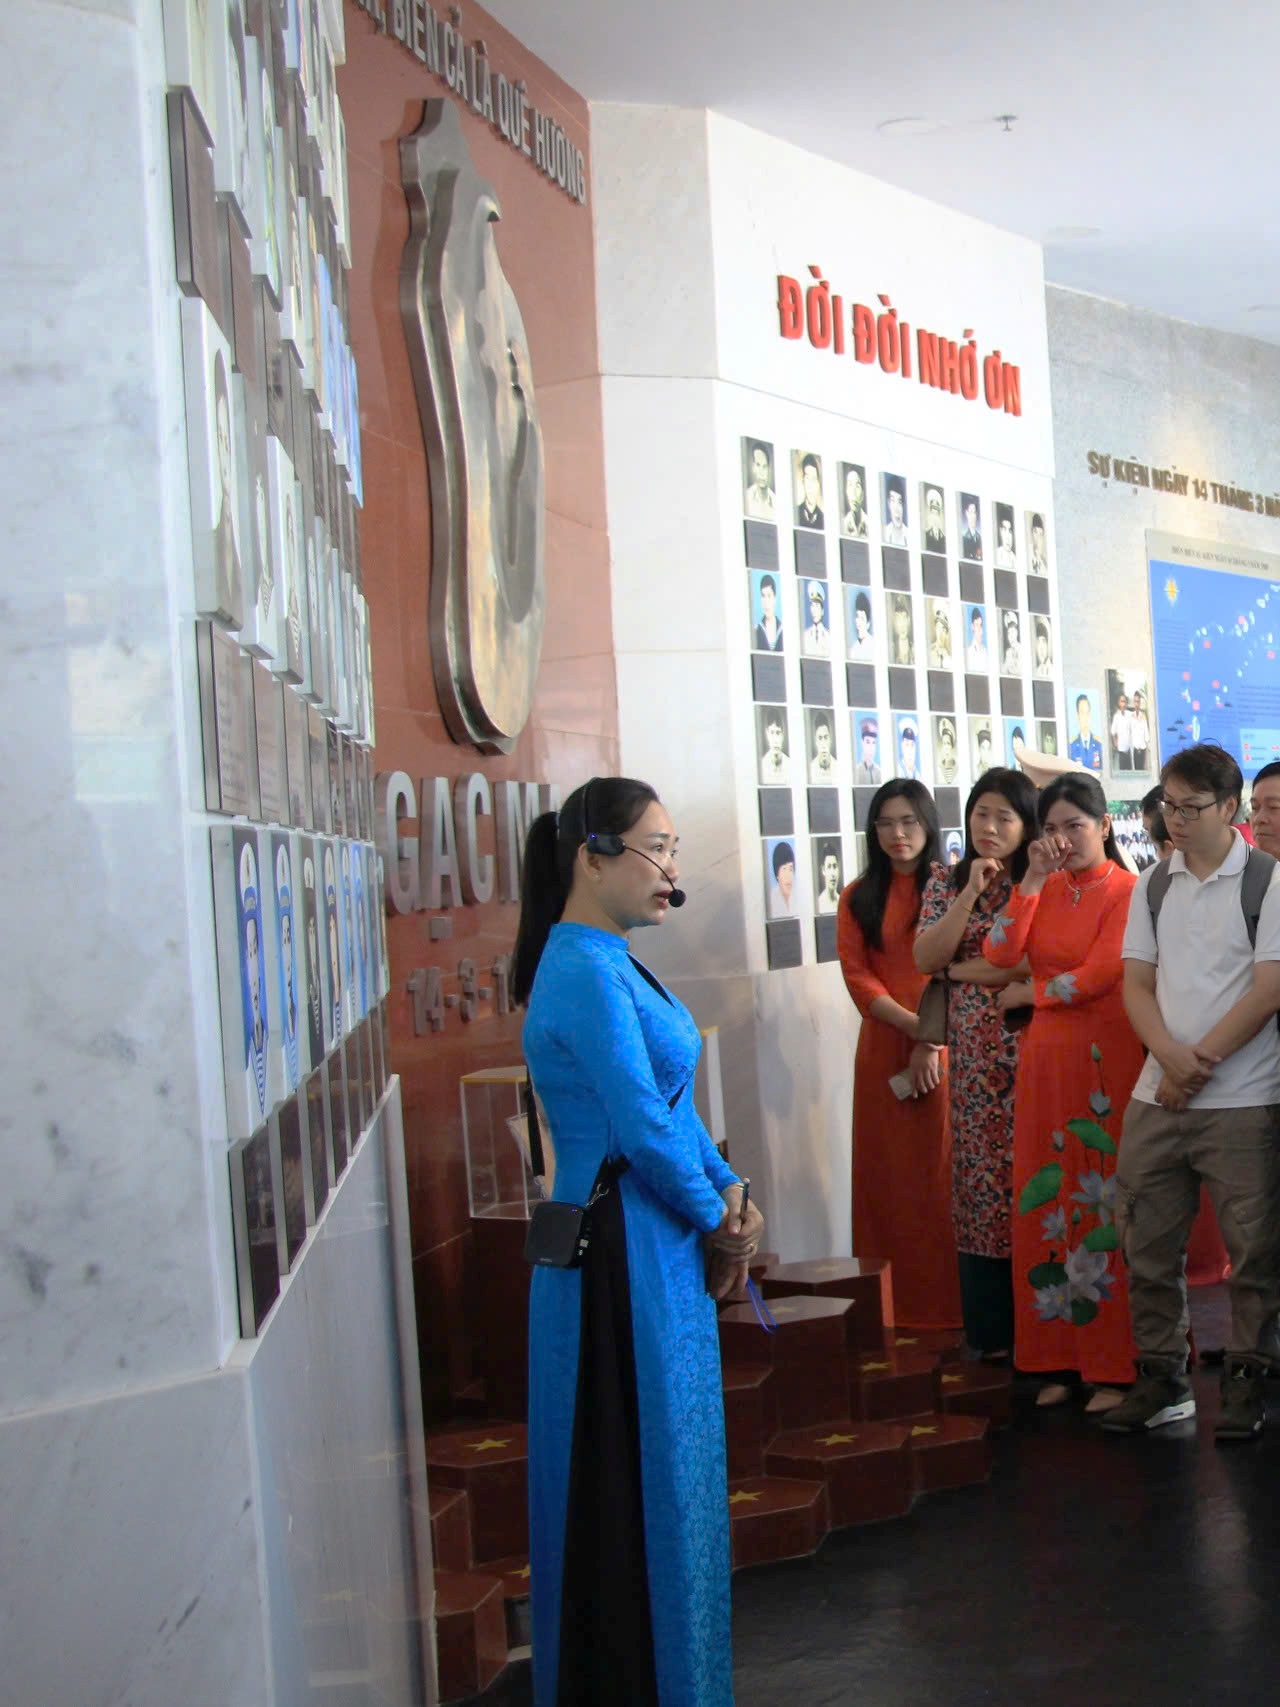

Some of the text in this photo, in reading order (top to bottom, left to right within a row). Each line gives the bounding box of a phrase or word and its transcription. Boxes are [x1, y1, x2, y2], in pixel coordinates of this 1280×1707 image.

[468, 40, 495, 123] LÀ
[494, 72, 531, 157] QUÊ
[532, 108, 586, 206] HƯƠNG
[777, 264, 1022, 417] ĐỜI ĐỜI NHỚ ƠN
[1086, 450, 1111, 489] SỰ
[1113, 455, 1150, 496] KIỆN
[1151, 465, 1189, 497] NGÀY
[1191, 478, 1208, 501] 14
[1210, 480, 1255, 513] THÁNG
[1255, 493, 1264, 515] 3
[376, 769, 496, 940] GẠC
